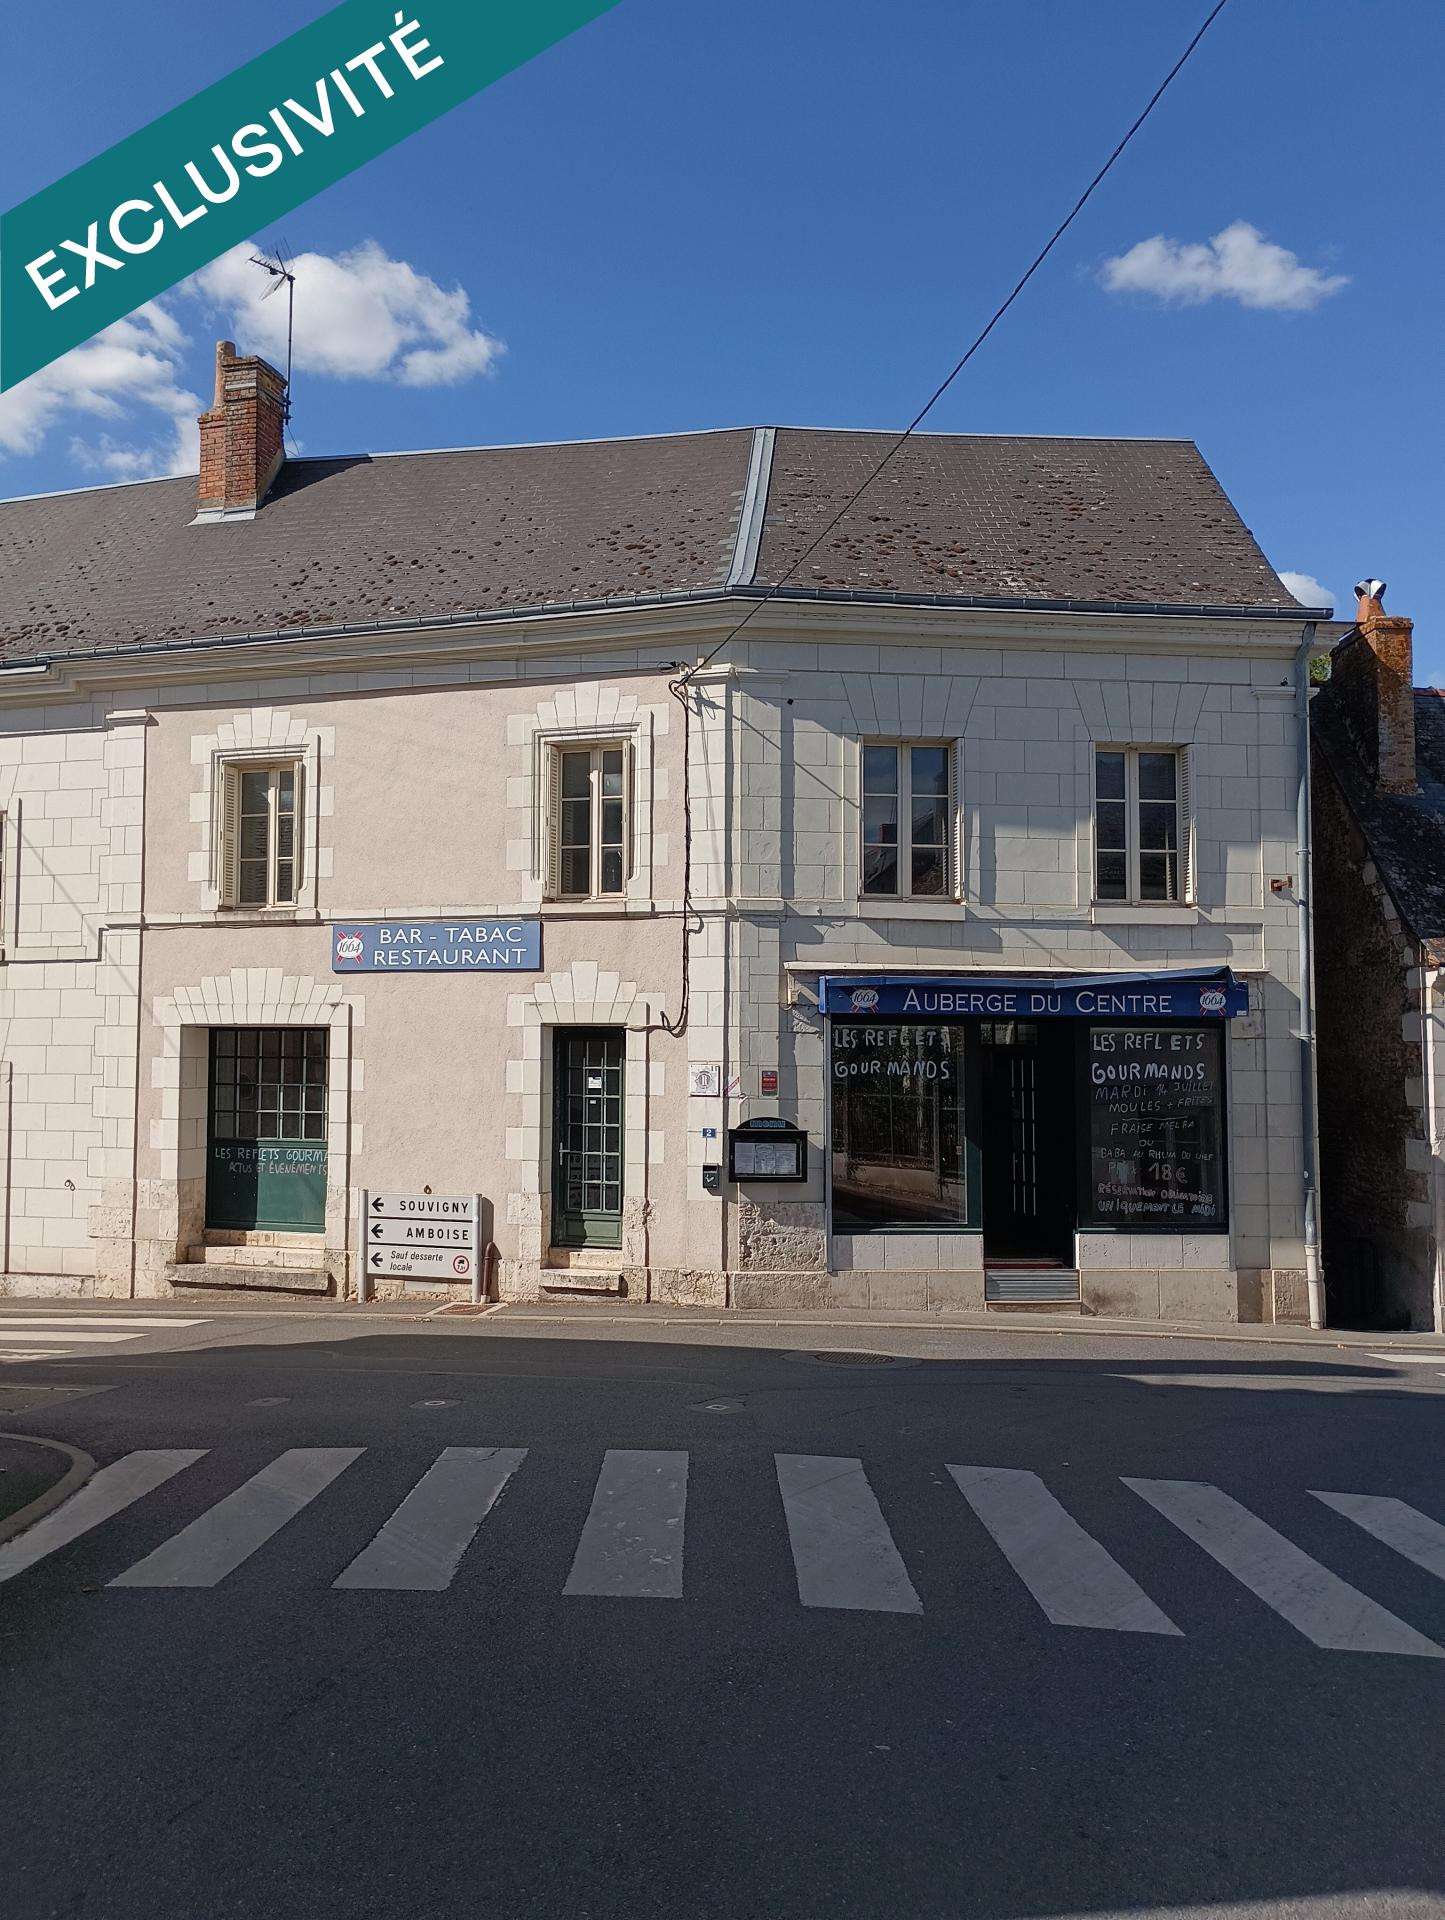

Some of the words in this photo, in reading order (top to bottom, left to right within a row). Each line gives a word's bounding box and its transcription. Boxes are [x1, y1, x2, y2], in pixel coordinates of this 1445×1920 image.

[380, 928, 423, 944] BAR
[444, 926, 522, 943] TABAC
[338, 940, 362, 954] 1664
[373, 948, 527, 965] RESTAURANT
[853, 990, 877, 1003] 1664
[1031, 994, 1061, 1013] DU
[1201, 995, 1225, 1007] 1664
[834, 1029, 857, 1049] LES
[1093, 1033, 1116, 1052] LES
[834, 1060, 949, 1080] GOURMANDS
[1092, 1062, 1205, 1084] GOURMANDS
[1109, 1101, 1160, 1113] MOULES
[215, 1148, 231, 1159] LES
[399, 1200, 469, 1214] SOUVIGNY
[406, 1227, 469, 1241] AMBOISE
[390, 1250, 408, 1260] Sauf
[410, 1251, 444, 1262] desserte
[389, 1262, 413, 1272] locale
